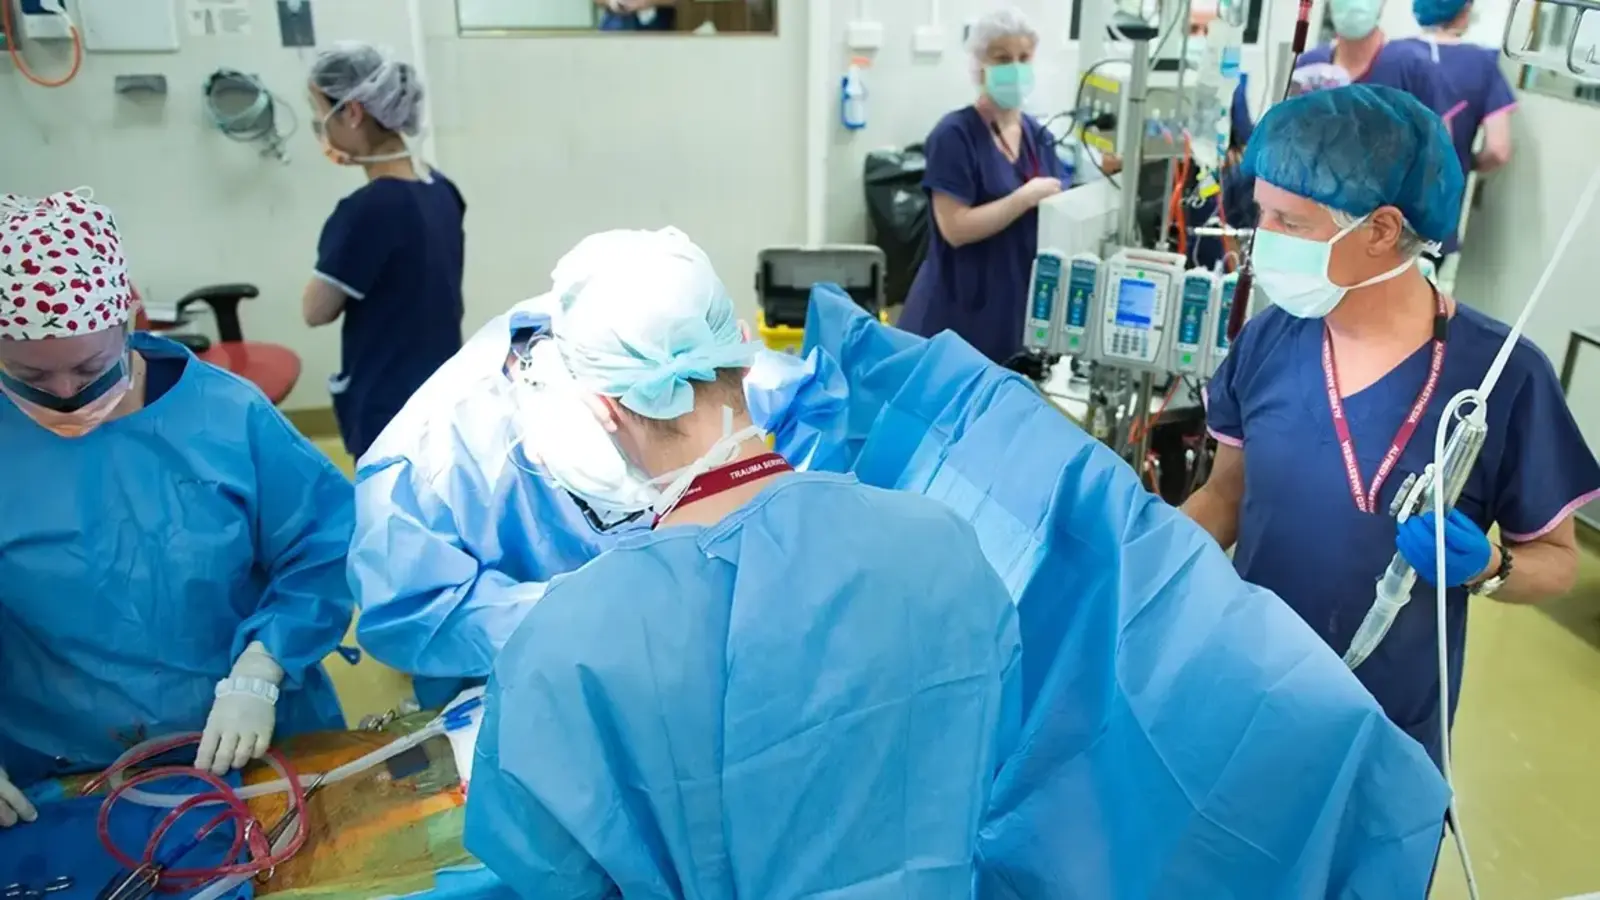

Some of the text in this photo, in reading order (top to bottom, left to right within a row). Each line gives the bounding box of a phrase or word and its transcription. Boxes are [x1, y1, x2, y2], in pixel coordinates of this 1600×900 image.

[1407, 340, 1444, 423] ALFRED ANAESTHESIA
[1328, 388, 1342, 419] ALFRED
[729, 463, 763, 480] TRAUMA
[1341, 440, 1363, 496] ANAESTHESIA
[1379, 444, 1400, 476] ALFRED
